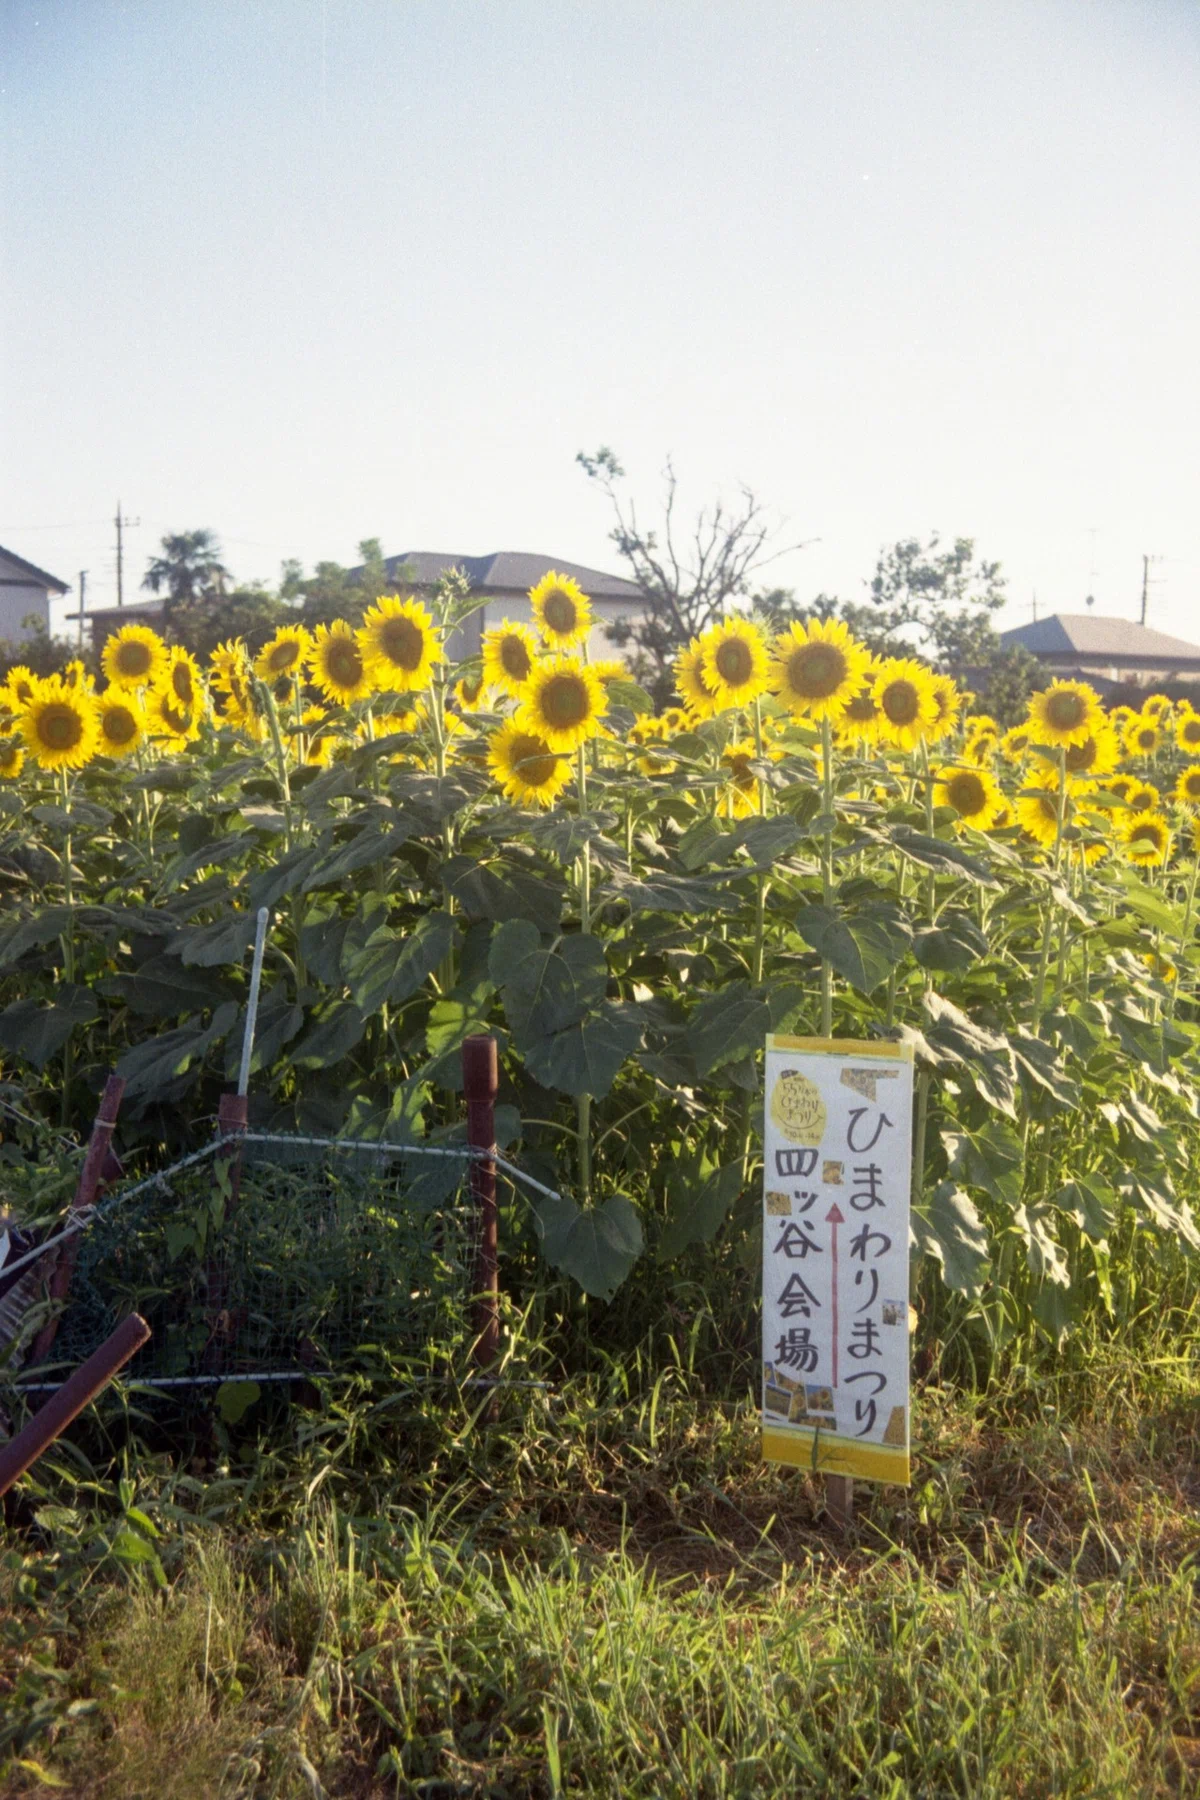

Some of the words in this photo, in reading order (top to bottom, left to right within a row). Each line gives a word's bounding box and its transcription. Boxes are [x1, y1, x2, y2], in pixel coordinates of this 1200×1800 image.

[781, 1096, 819, 1113] ひまわり
[786, 1109, 812, 1125] まつり
[844, 1107, 894, 1438] ひまわりまつり
